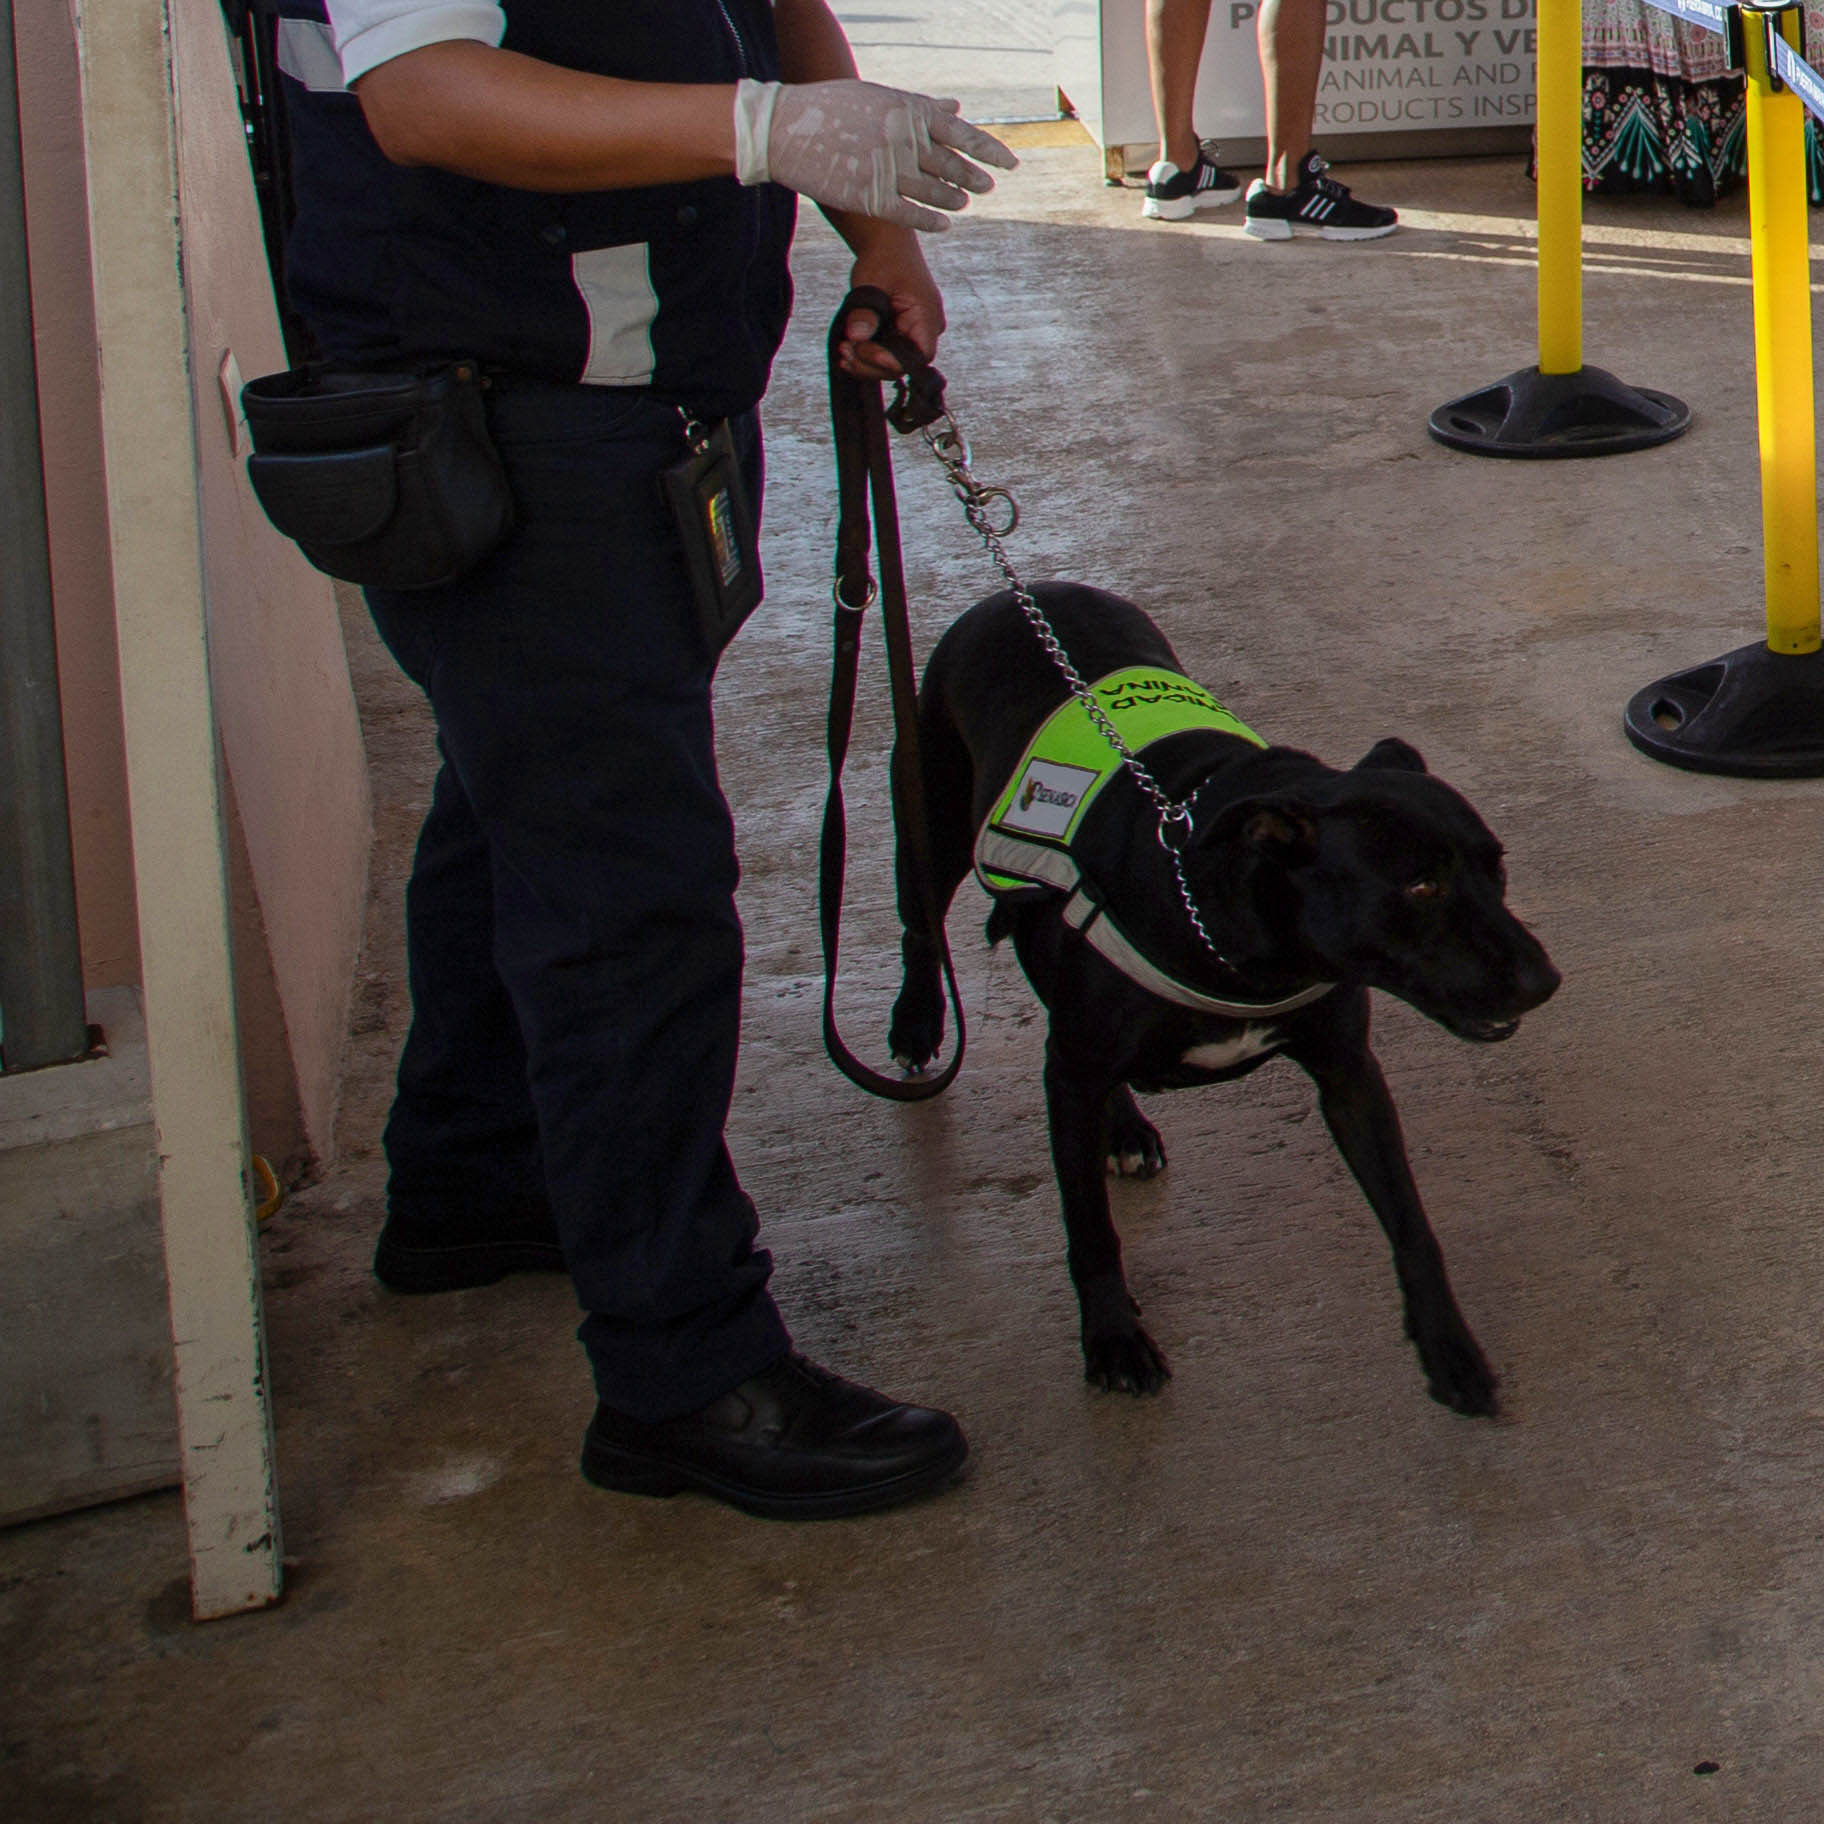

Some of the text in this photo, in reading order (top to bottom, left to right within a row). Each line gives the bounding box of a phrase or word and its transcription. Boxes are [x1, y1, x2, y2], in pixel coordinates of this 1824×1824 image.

[1455, 30, 1481, 56] Y
[1320, 63, 1521, 92] ANIMAL AND
